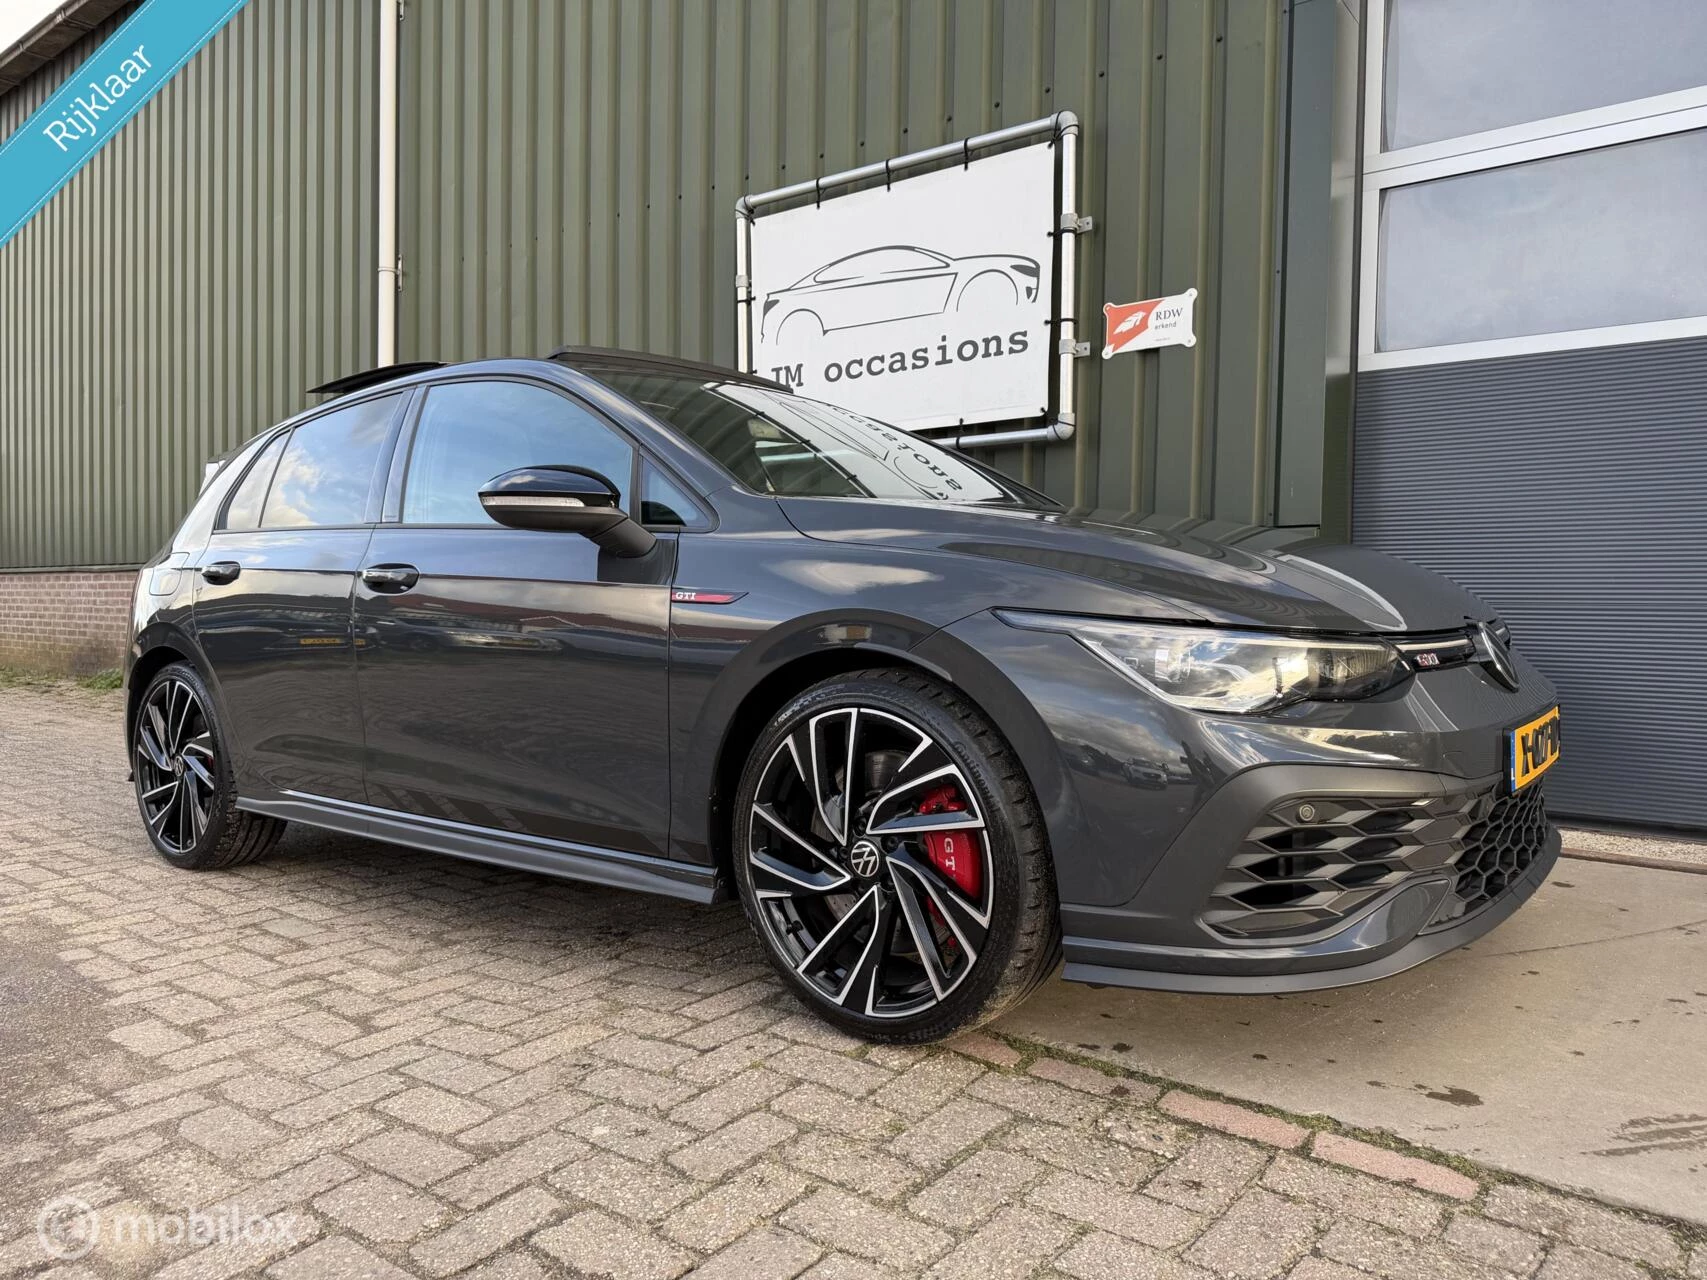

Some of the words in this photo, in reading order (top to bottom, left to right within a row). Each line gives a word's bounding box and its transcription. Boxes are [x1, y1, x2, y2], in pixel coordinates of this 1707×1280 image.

[1155, 307, 1184, 321] RDW
[1154, 321, 1177, 330] erkend
[823, 330, 1030, 383] occasions
[675, 591, 697, 600] GTI
[944, 837, 956, 872] GT
